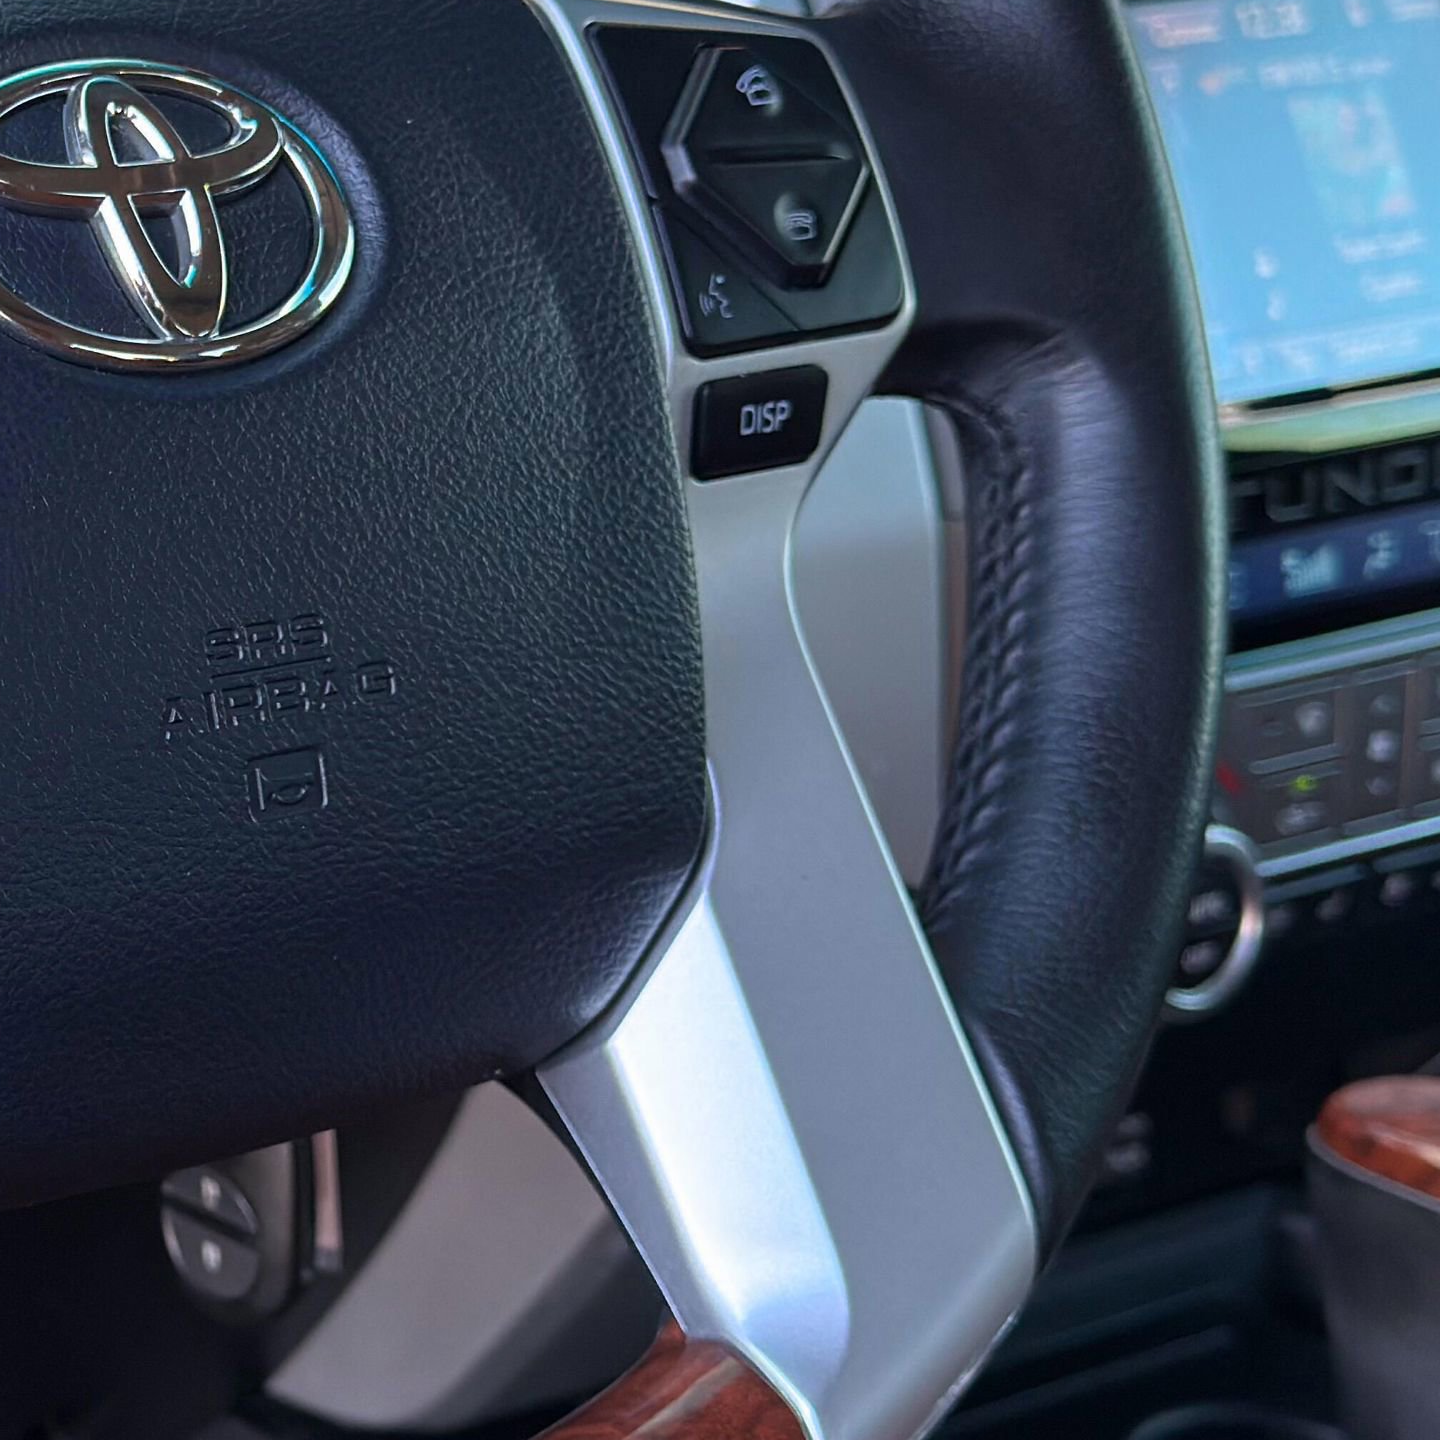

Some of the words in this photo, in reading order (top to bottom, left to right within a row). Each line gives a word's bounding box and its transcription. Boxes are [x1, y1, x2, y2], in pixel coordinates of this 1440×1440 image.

[739, 400, 792, 436] DISP
[205, 613, 329, 662] SRS
[164, 662, 397, 740] AIRBAG
